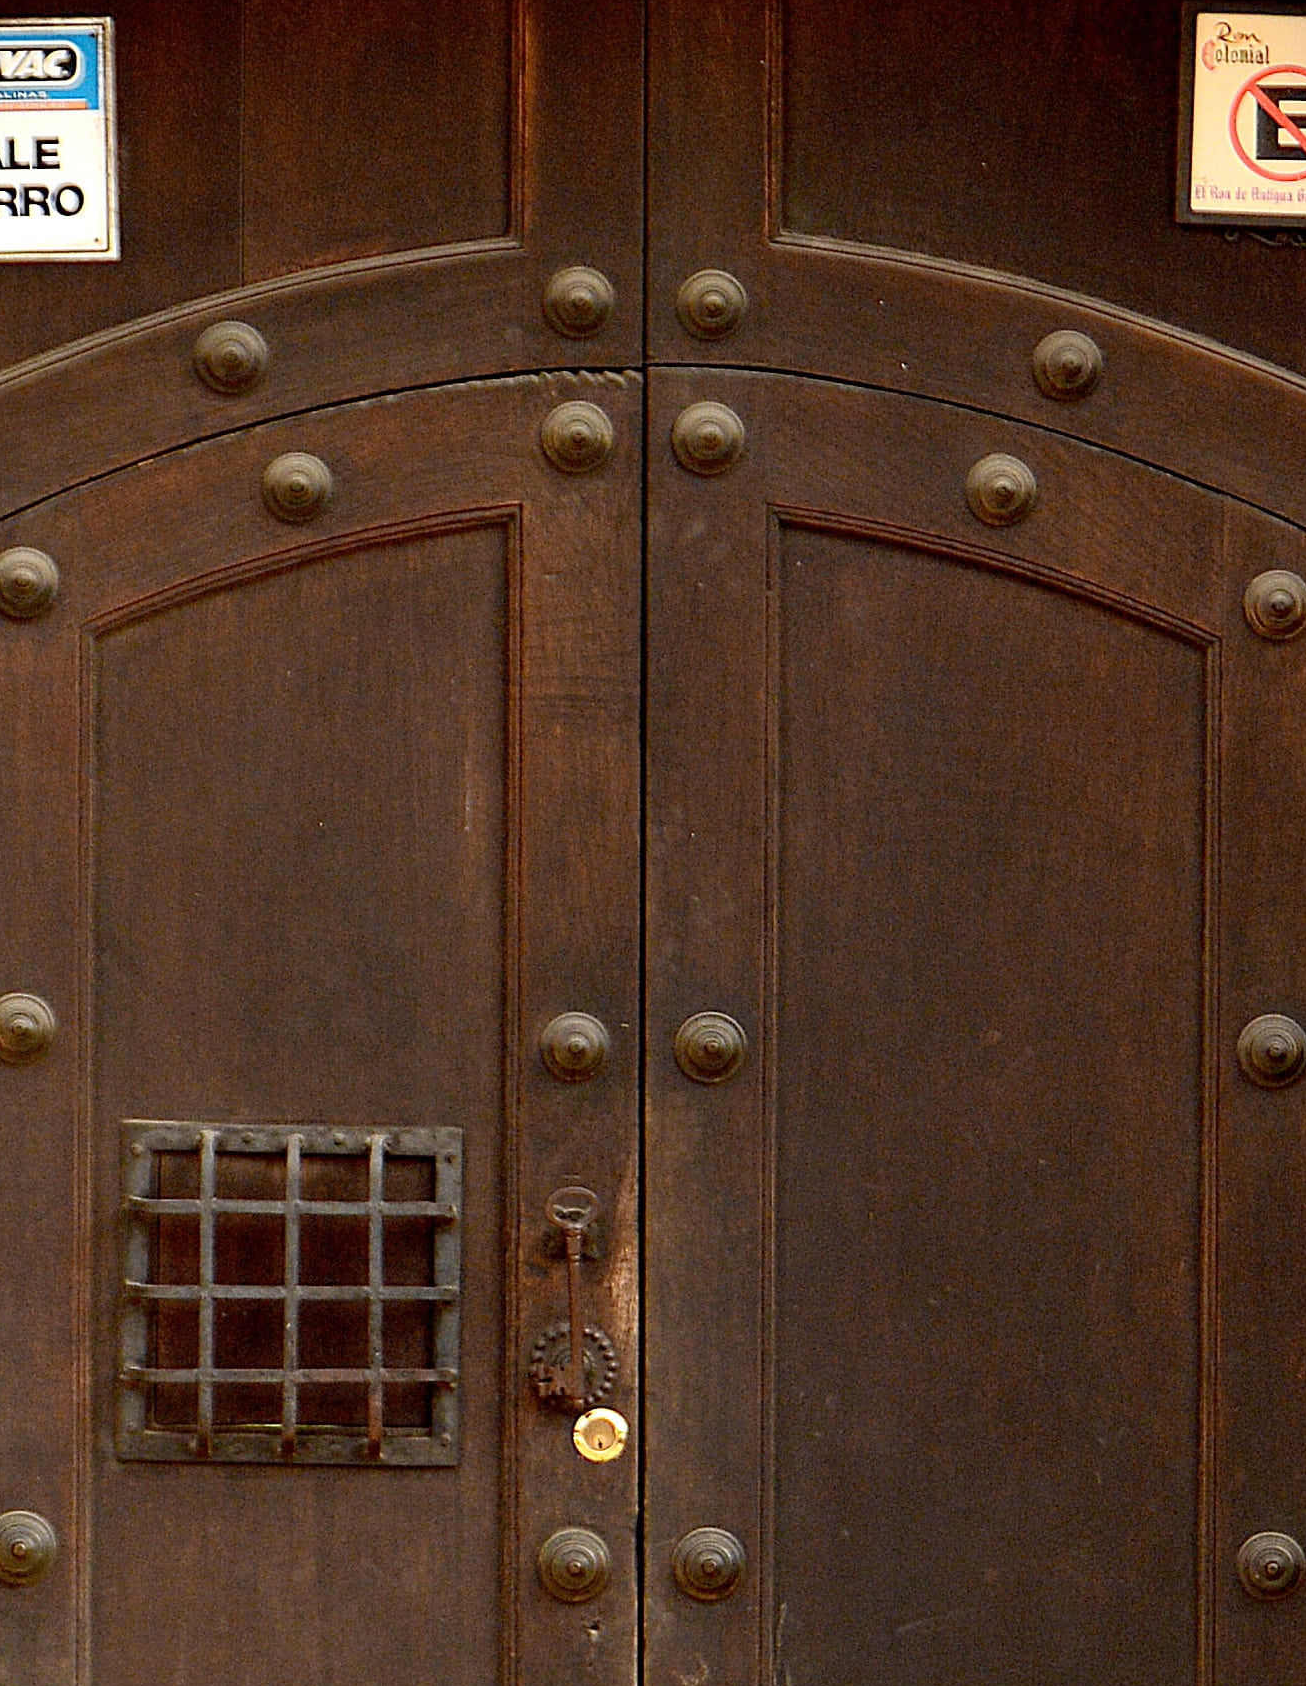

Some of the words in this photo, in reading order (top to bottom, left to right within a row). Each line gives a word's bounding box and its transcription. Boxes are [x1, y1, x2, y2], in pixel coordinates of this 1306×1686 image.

[1213, 21, 1261, 43] Ron
[1202, 39, 1270, 70] Colonial
[1251, 185, 1293, 204] Antigua
